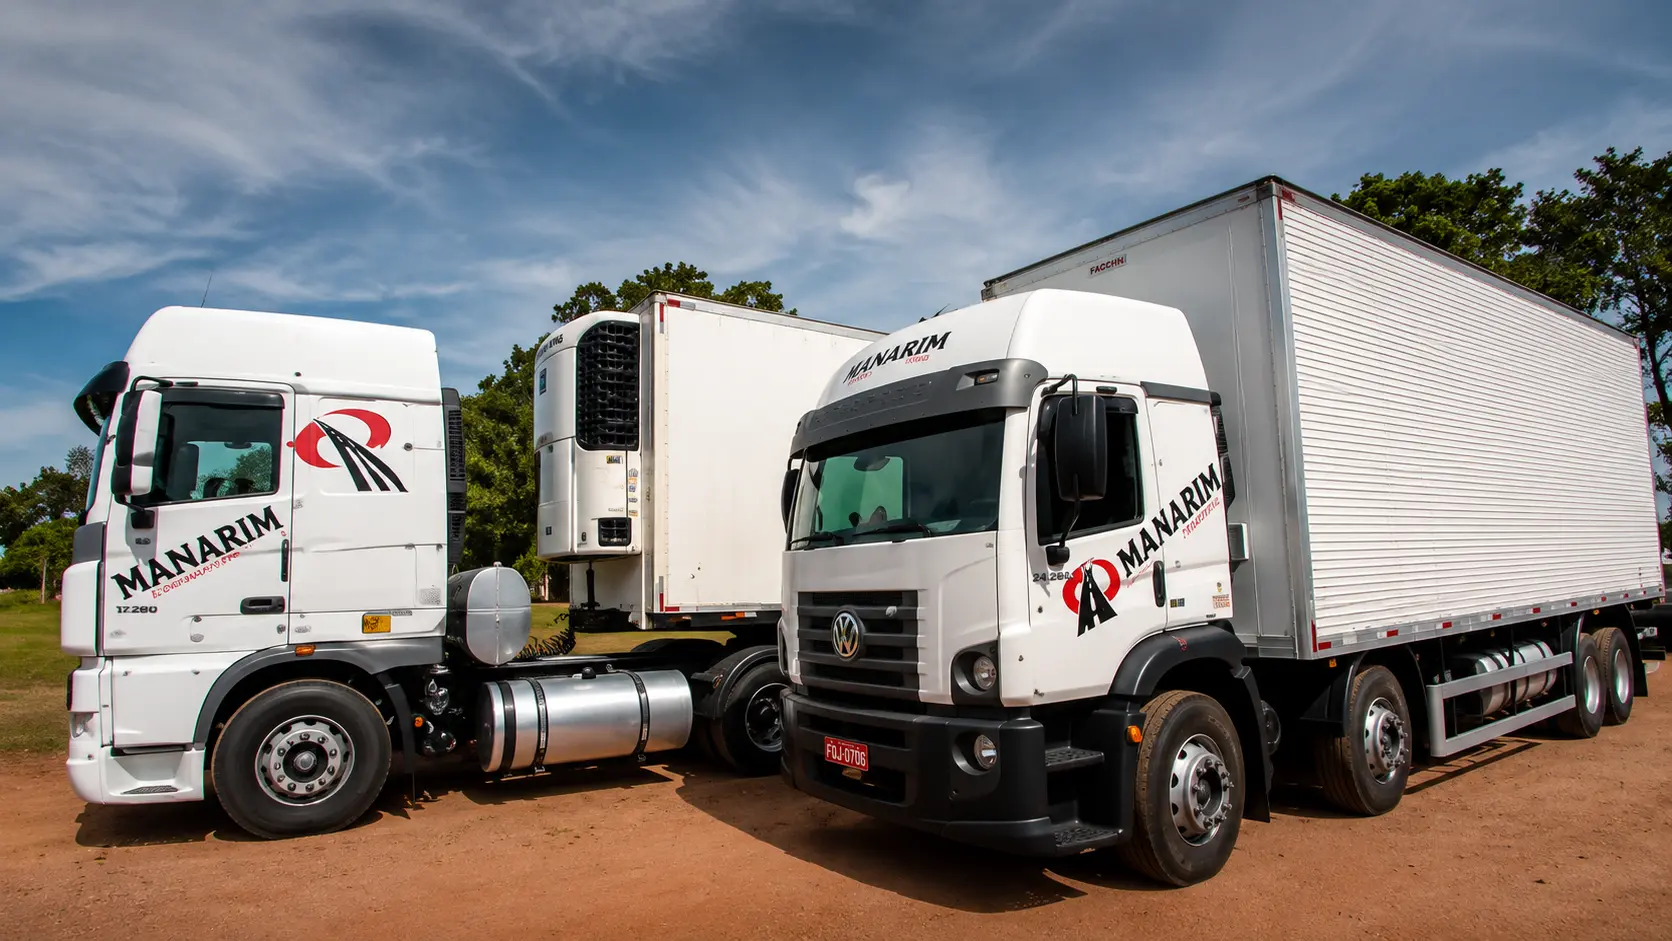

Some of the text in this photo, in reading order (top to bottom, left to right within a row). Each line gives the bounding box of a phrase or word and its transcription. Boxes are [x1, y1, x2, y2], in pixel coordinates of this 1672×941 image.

[843, 331, 952, 384] MANARIM
[111, 505, 284, 600] MANARIM
[1116, 463, 1221, 578] MANARIM
